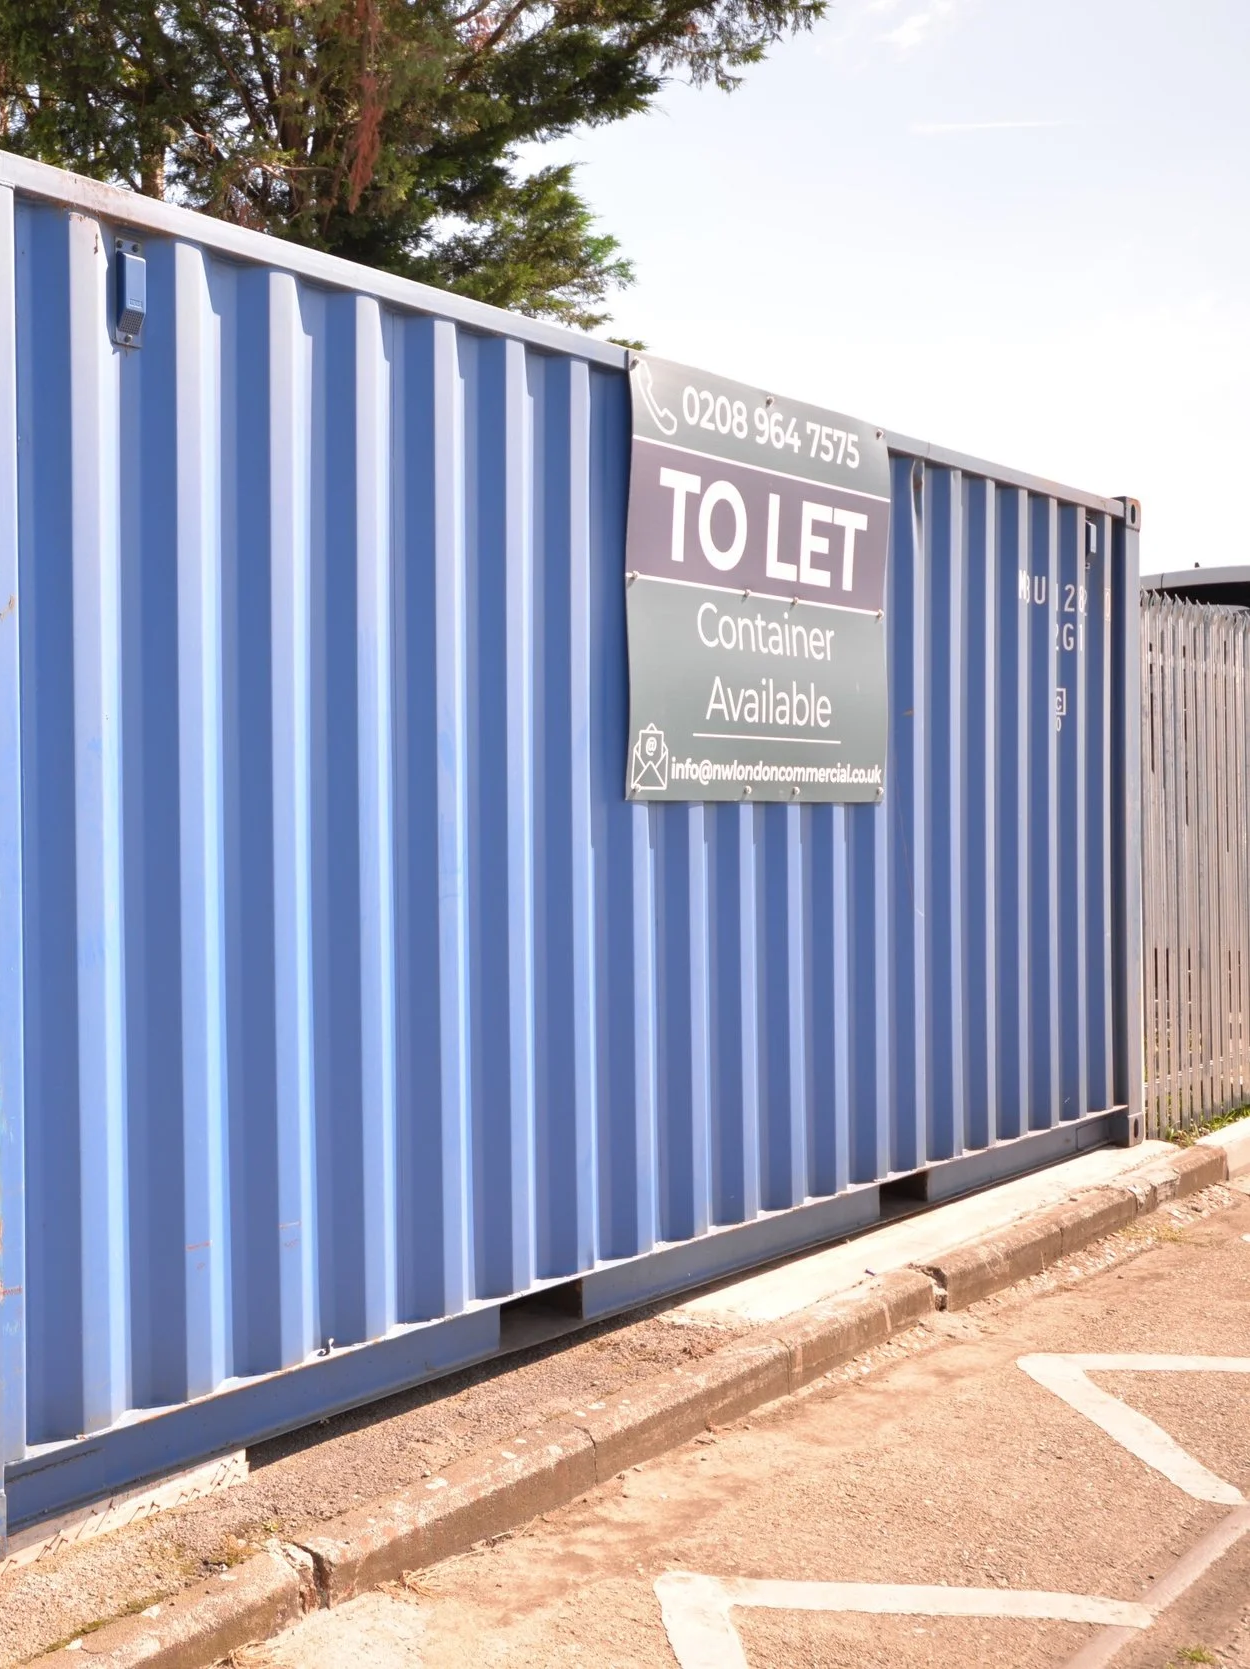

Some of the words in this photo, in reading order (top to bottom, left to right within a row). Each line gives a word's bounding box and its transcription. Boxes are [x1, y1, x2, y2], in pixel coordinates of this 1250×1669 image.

[682, 385, 748, 439] 0208
[754, 407, 801, 454] 964
[805, 421, 860, 469] 7575
[659, 466, 748, 571] TO
[766, 492, 868, 592] LET
[697, 602, 835, 661] Container
[705, 675, 832, 728] Available
[671, 756, 882, 786] info@nwlondoncommercial.co.uk
